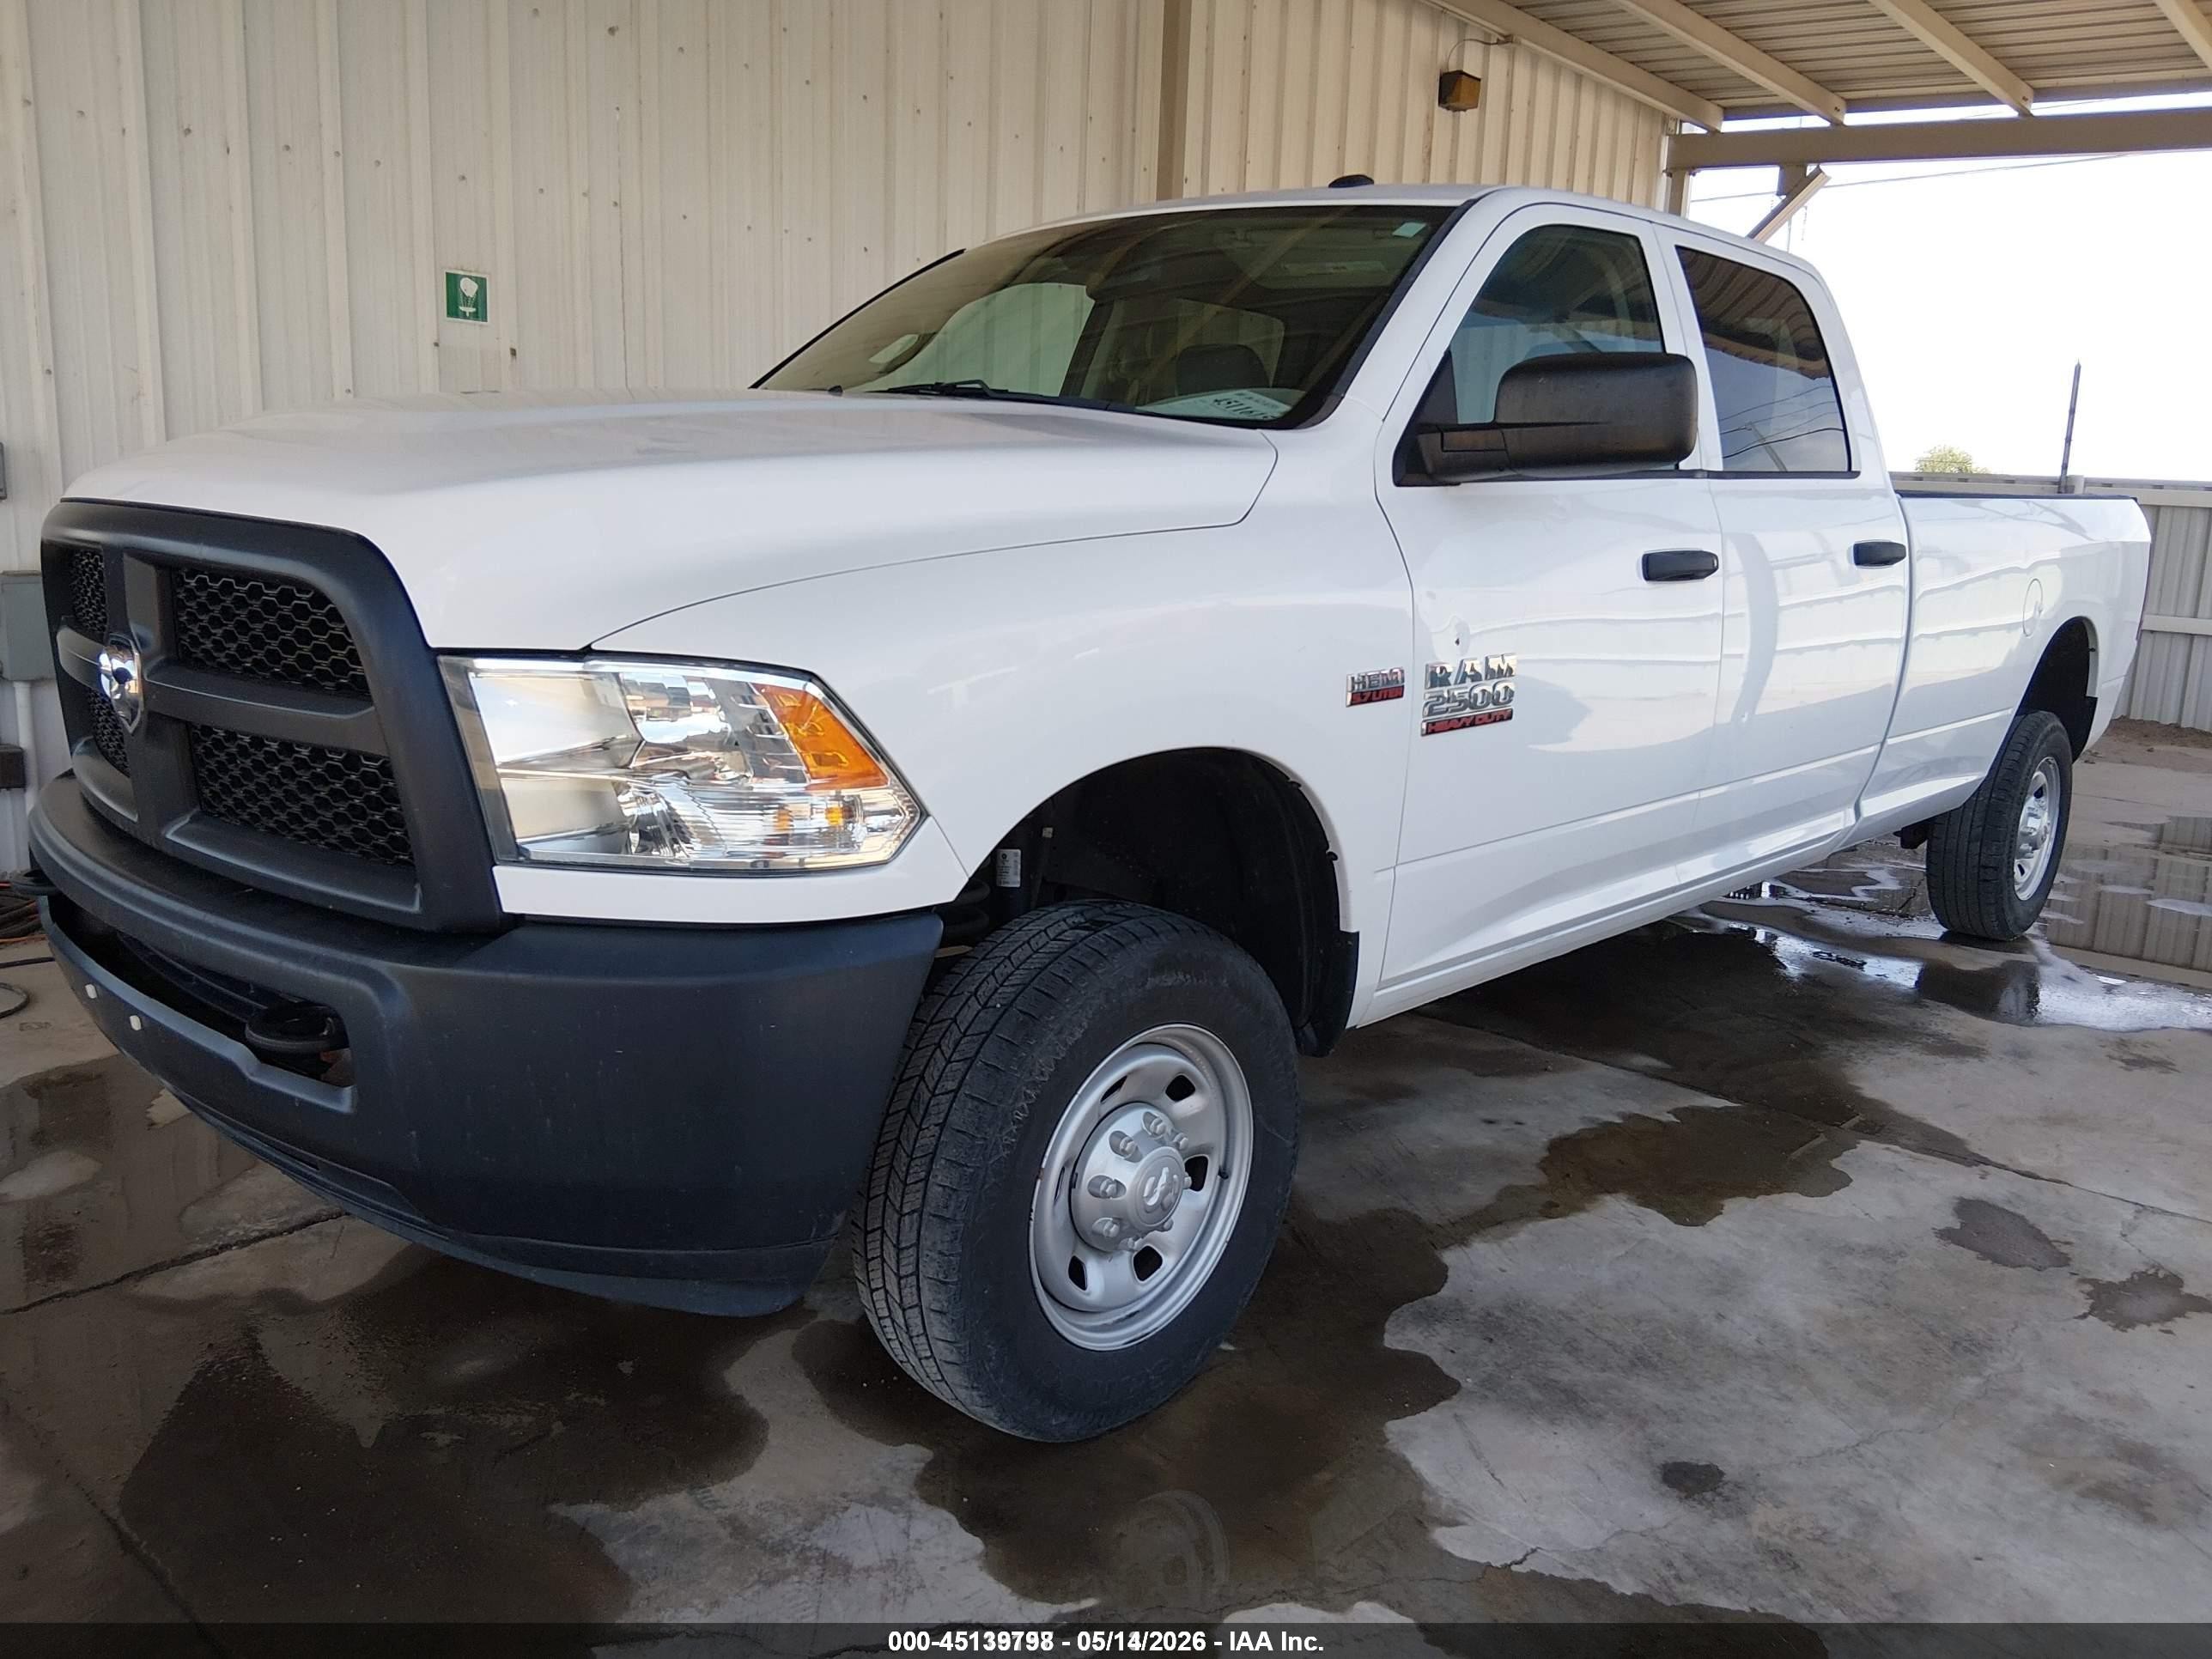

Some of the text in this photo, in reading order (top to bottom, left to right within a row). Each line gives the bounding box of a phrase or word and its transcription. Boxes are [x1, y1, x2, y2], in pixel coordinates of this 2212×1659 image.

[1348, 666, 1405, 692] HEMI
[1425, 653, 1517, 690] RAM
[1371, 687, 1403, 702] LITER
[1423, 680, 1516, 718] 2500
[1427, 708, 1512, 733] HEAVY DUTY
